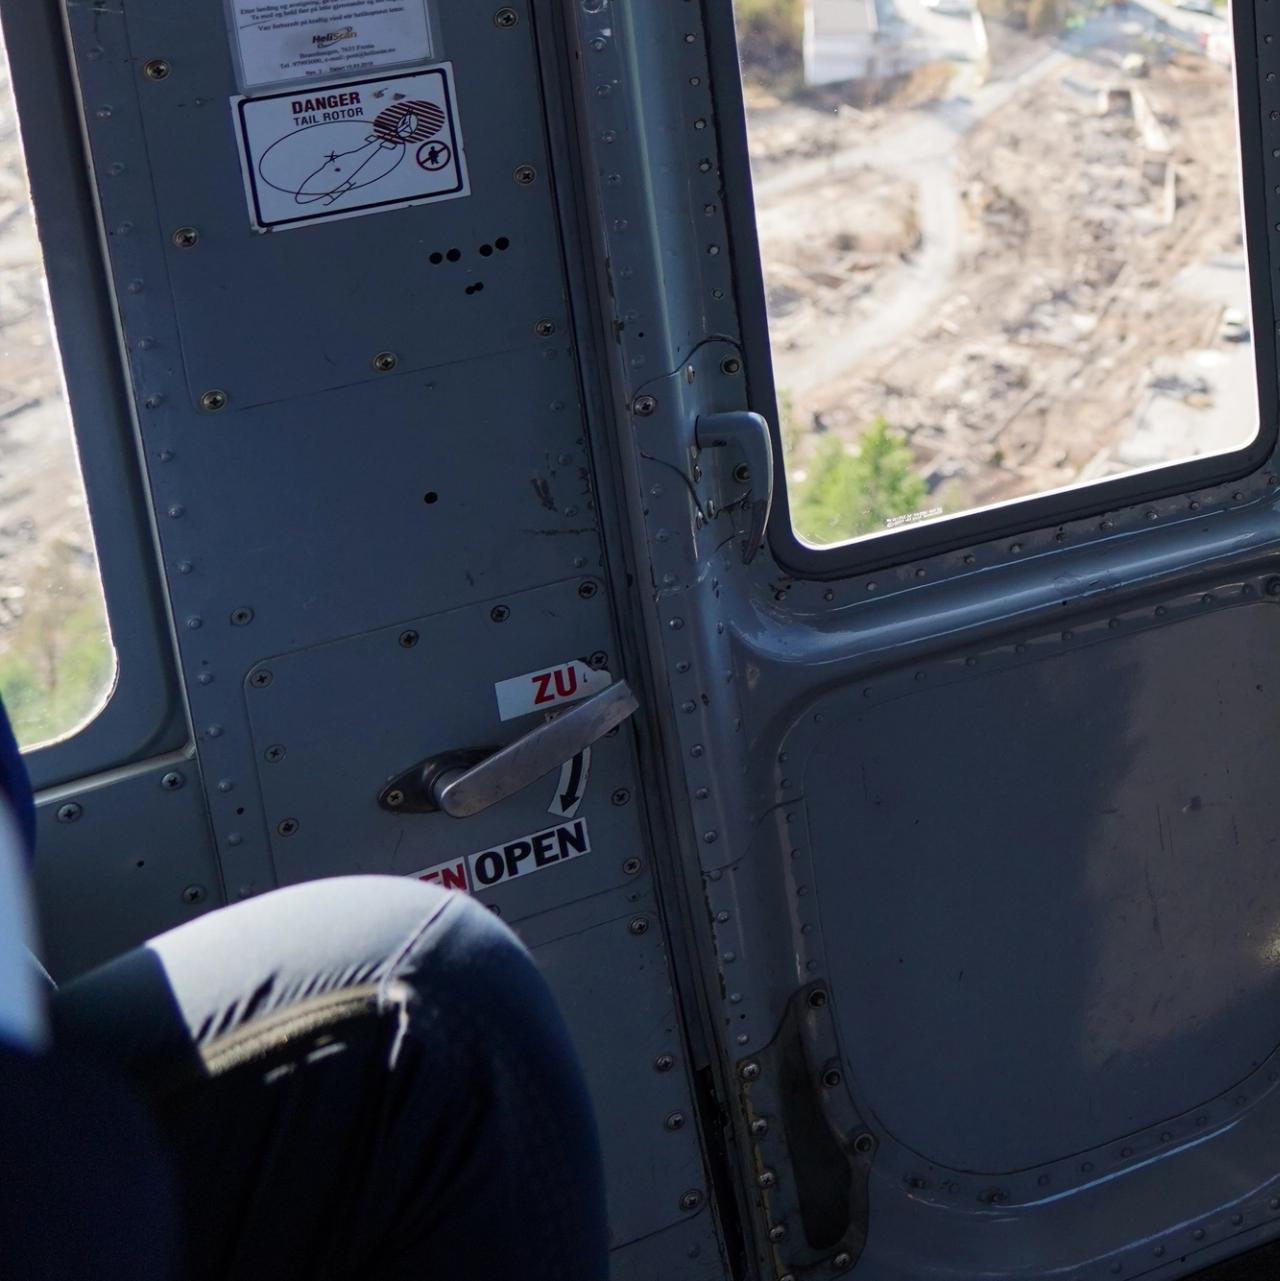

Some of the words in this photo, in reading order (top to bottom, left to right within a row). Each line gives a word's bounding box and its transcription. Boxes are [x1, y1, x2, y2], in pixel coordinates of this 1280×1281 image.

[312, 31, 357, 44] HeliScan
[291, 91, 361, 115] DANGER
[293, 114, 320, 126] TAIL
[322, 107, 364, 122] ROTOR
[531, 665, 578, 705] ZU
[474, 821, 588, 885] OPEN
